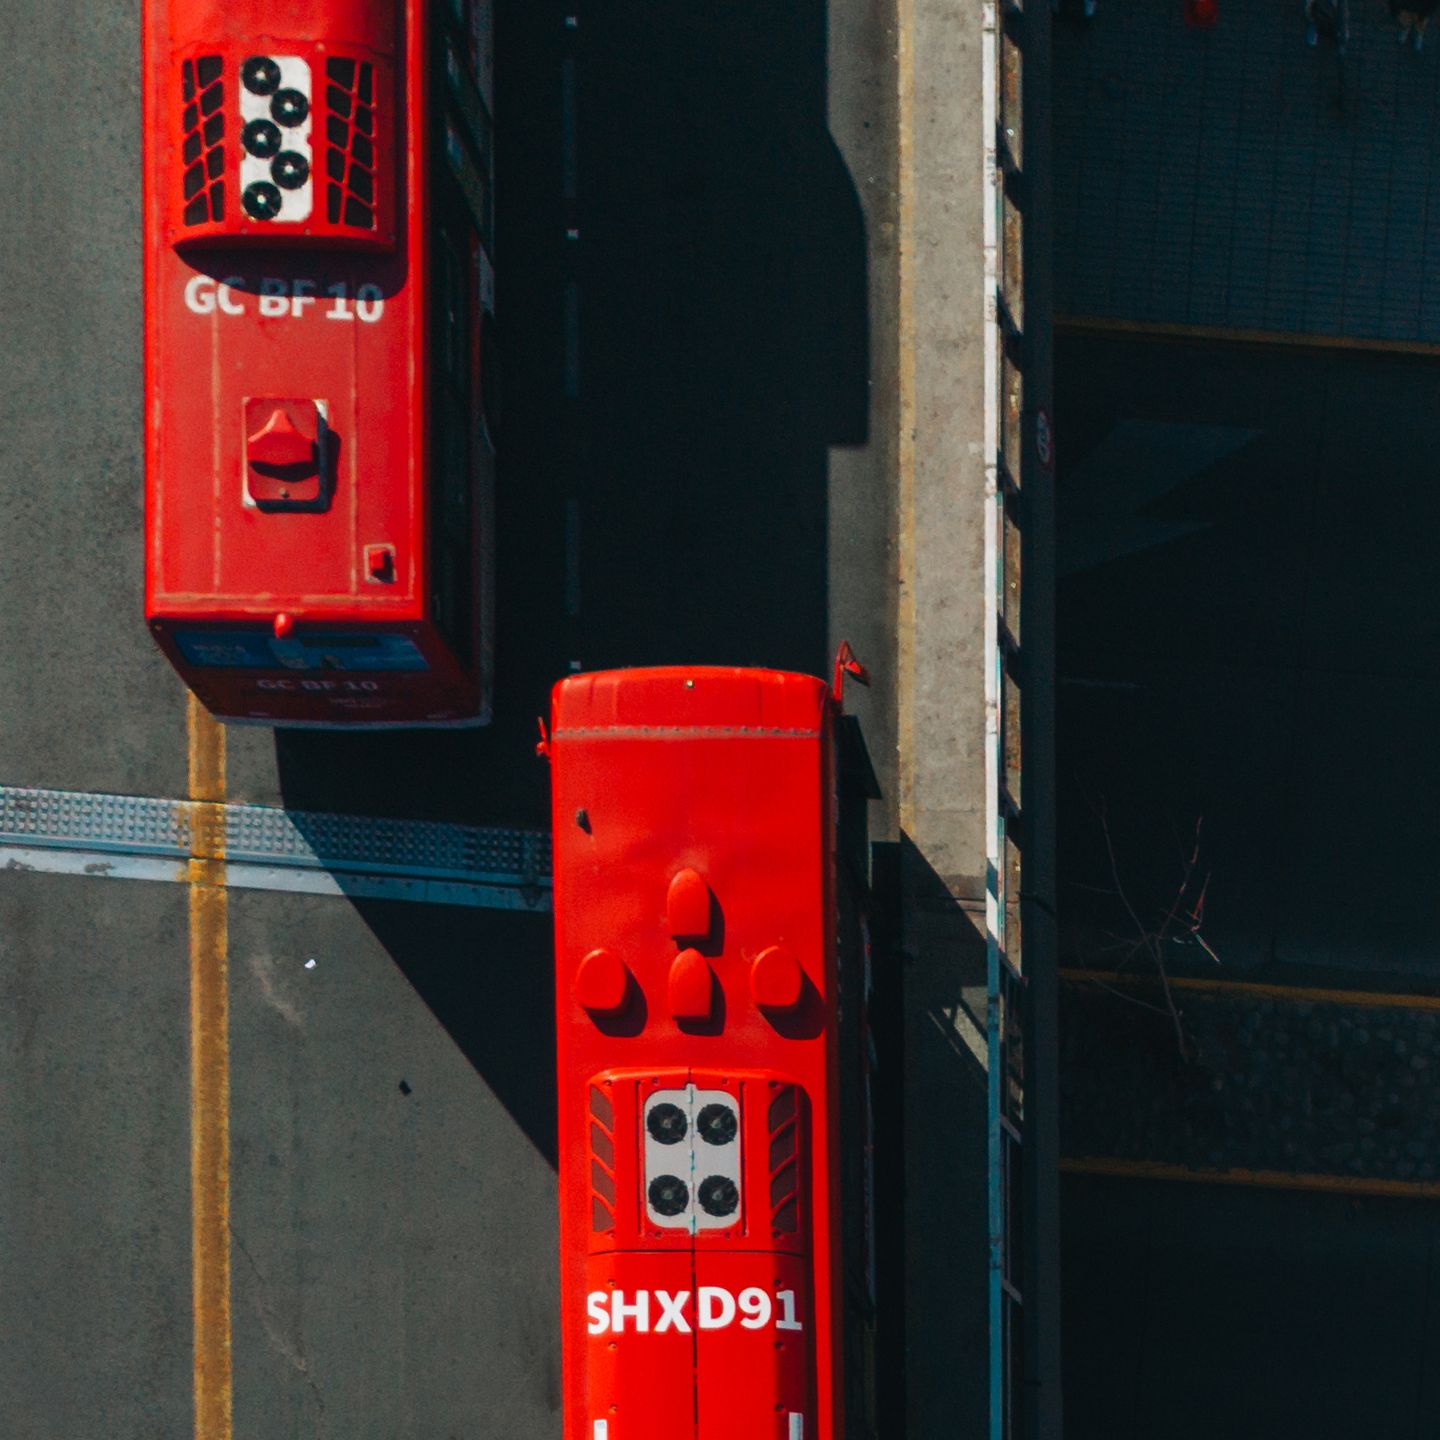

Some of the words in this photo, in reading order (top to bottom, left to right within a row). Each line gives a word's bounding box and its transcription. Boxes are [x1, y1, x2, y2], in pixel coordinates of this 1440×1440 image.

[183, 273, 246, 316] GC
[259, 276, 317, 318] BF
[325, 281, 385, 323] 10
[586, 1285, 803, 1336] SHXD91
